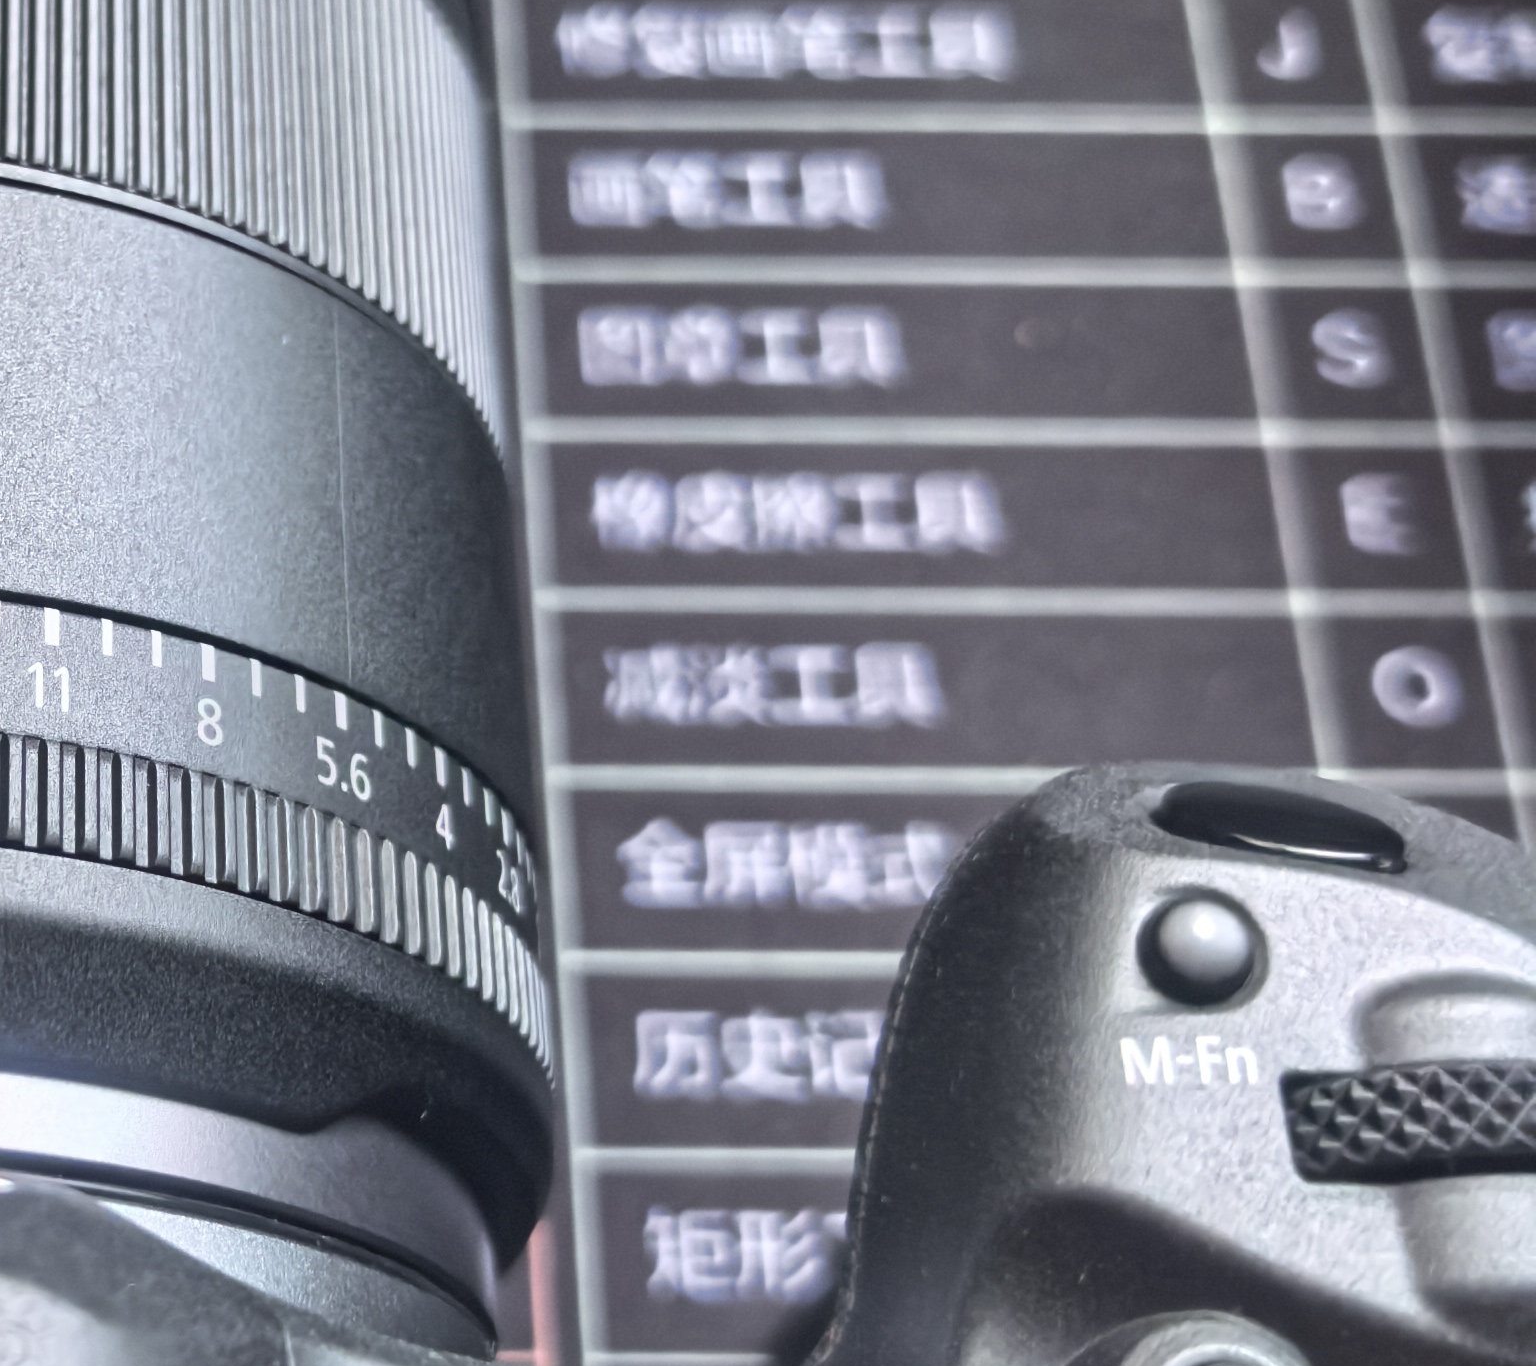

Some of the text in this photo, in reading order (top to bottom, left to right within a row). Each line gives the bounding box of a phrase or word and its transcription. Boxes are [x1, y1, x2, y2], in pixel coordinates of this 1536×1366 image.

[1255, 16, 1318, 83] J
[1279, 156, 1356, 231] B
[1308, 310, 1387, 390] S
[1338, 473, 1419, 555] E
[1368, 645, 1460, 729] O
[27, 661, 70, 713] 11
[197, 697, 225, 747] 8
[315, 736, 372, 801] 5.6
[435, 803, 453, 850] 4
[1118, 1035, 1259, 1086] M-Fn
